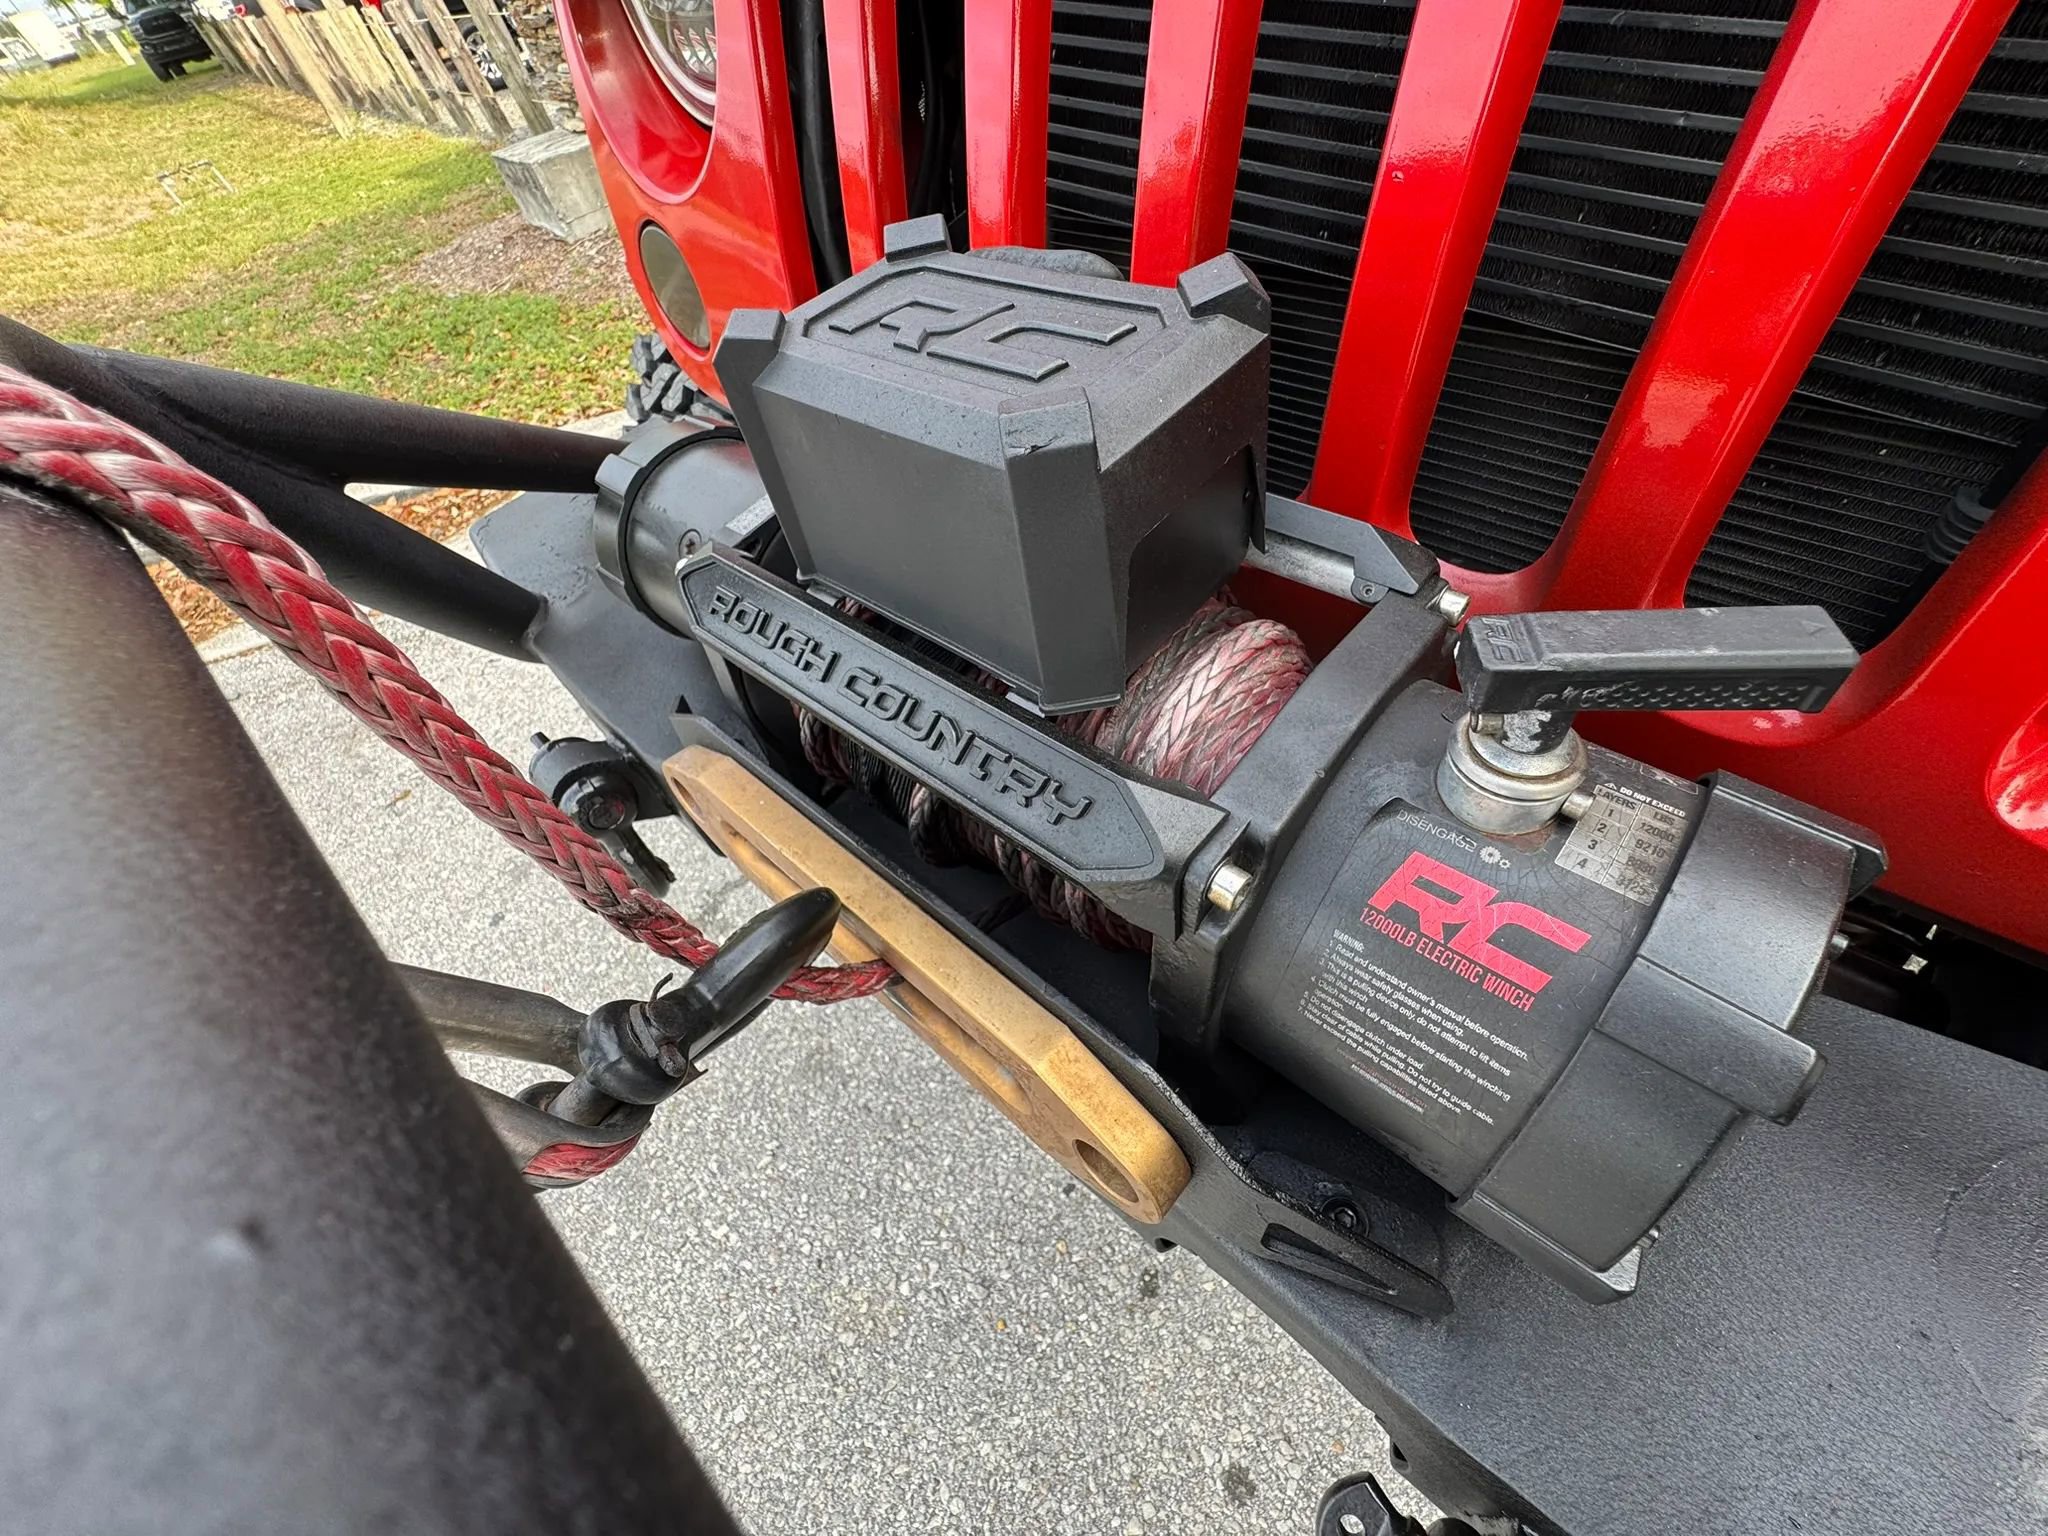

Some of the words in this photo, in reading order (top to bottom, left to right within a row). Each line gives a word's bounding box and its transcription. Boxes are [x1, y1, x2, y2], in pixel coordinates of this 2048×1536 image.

[828, 300, 1137, 382] RC
[708, 586, 841, 683] ROUGH
[842, 666, 1096, 825] COUNTRY
[1587, 839, 1598, 850] 3
[1597, 788, 1637, 810] LAYERS
[1653, 811, 1676, 826] LBS
[1597, 822, 1607, 833] 2
[1620, 786, 1633, 797] DO
[1633, 792, 1653, 804] NOT
[1652, 799, 1686, 818] EXCEED
[1576, 858, 1588, 869] 4
[1359, 906, 1417, 948] 12000LB
[1415, 934, 1486, 984] ELECTRIC
[1482, 972, 1536, 1012] WINCH
[1368, 850, 1592, 993] RC
[1328, 952, 1355, 972] Always
[1352, 966, 1371, 981] wear
[1369, 975, 1395, 996] safety
[1391, 988, 1422, 1011] glasses
[1419, 1004, 1443, 1023] when
[1440, 1017, 1466, 1038] using.
[1334, 978, 1349, 991] this
[1334, 942, 1355, 959] Read
[1353, 953, 1369, 967] and
[1367, 961, 1408, 990] understand
[1406, 984, 1437, 1007] owner's
[1435, 1000, 1465, 1024] manual
[1463, 1017, 1491, 1038] before
[1351, 977, 1377, 997] pulling
[1374, 990, 1400, 1010] device
[1426, 1021, 1441, 1034] not
[1439, 1029, 1471, 1053] attempt
[1477, 1051, 1490, 1063] lift
[1487, 1057, 1512, 1077] items
[1302, 1010, 1323, 1026] Never
[1321, 1022, 1347, 1041] exceed
[1345, 1037, 1358, 1048] the
[1355, 1044, 1380, 1063] pulling
[1377, 1058, 1418, 1087] capabilities
[1416, 1082, 1438, 1099] listed
[1305, 1002, 1322, 1017] Stay
[1320, 1011, 1338, 1026] clear
[1343, 1026, 1364, 1043] cable
[1362, 1038, 1383, 1054] while
[1417, 1073, 1432, 1085] not
[1429, 1081, 1443, 1093] try
[1449, 1093, 1473, 1112] guide
[1471, 1106, 1496, 1126] cable.
[1317, 978, 1340, 996] Clutch
[1337, 992, 1356, 1007] must
[1363, 1007, 1382, 1023] fully
[1378, 1016, 1412, 1041] engaged
[1409, 1035, 1436, 1055] before
[1432, 1049, 1464, 1073] starting
[1462, 1066, 1478, 1080] the
[1474, 1074, 1512, 1103] winching
[1319, 1001, 1333, 1013] not
[1329, 1008, 1366, 1034] disengage
[1364, 1029, 1387, 1047] clutch
[1385, 1042, 1408, 1059] under
[1405, 1054, 1426, 1071] load.
